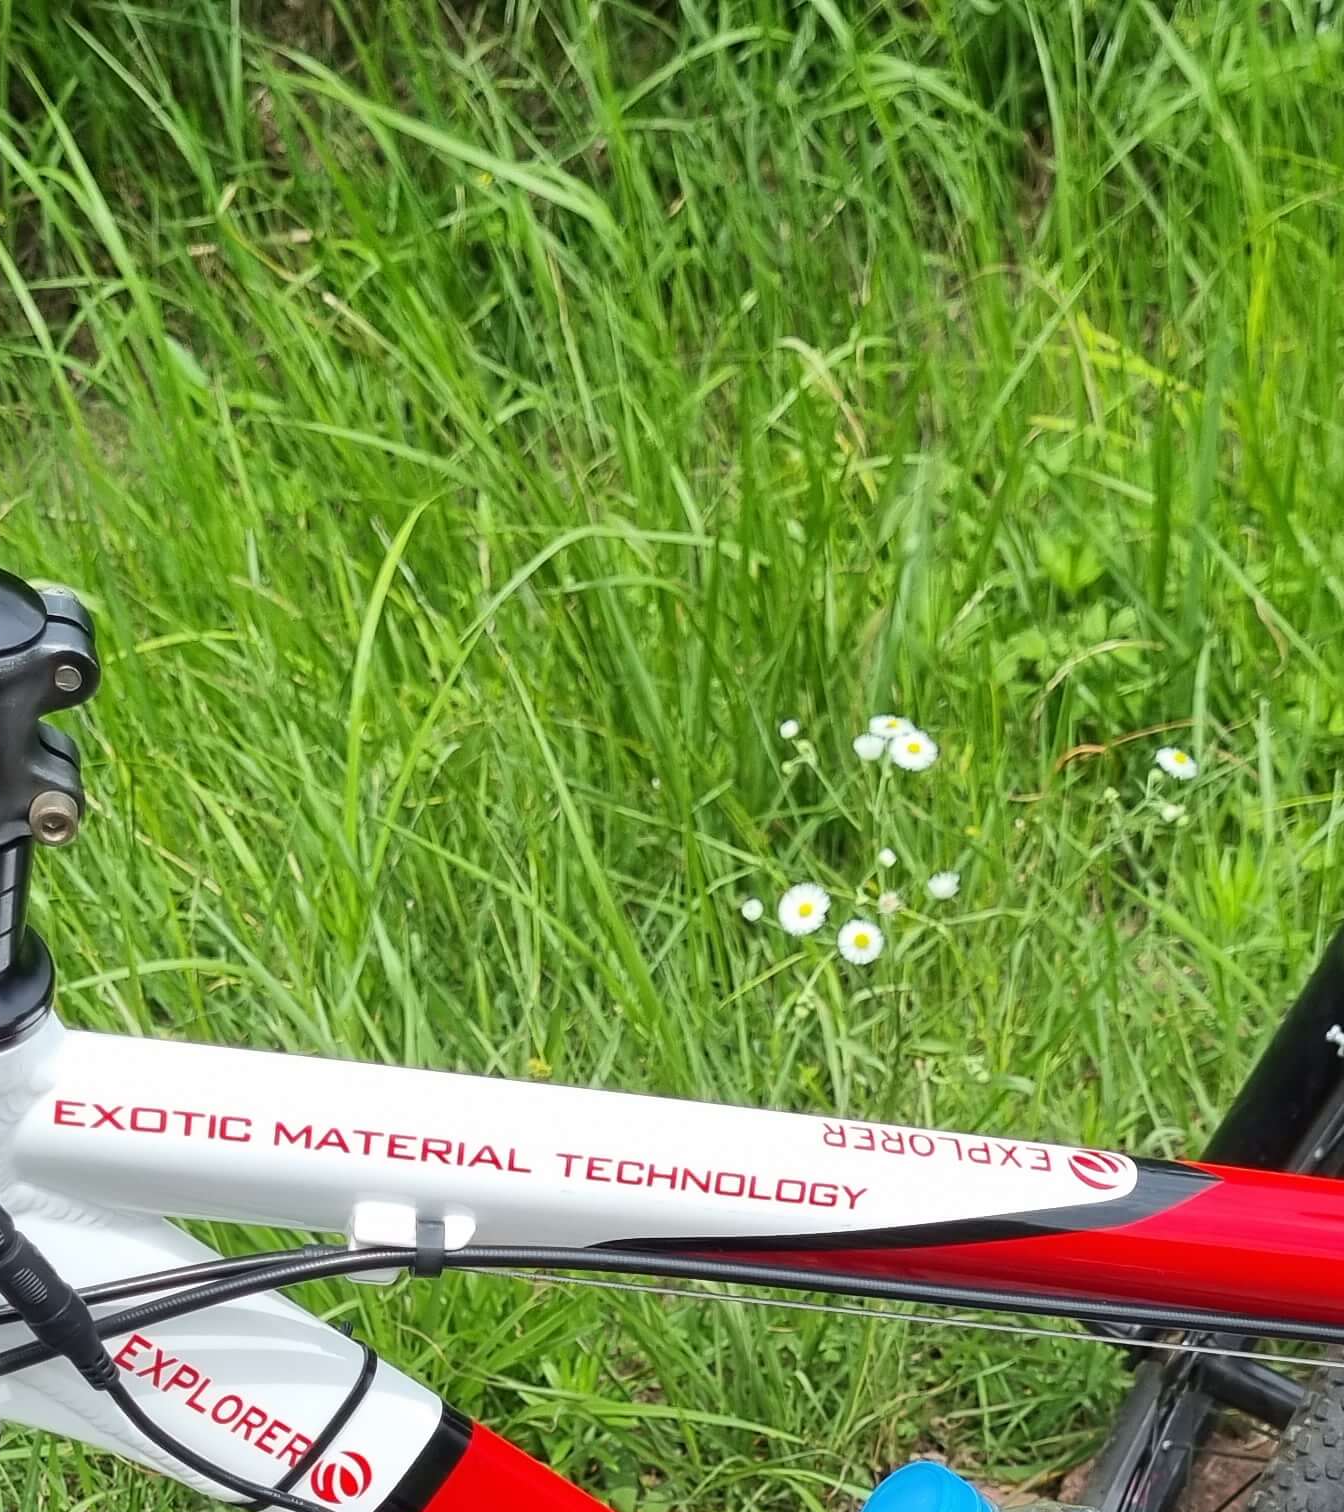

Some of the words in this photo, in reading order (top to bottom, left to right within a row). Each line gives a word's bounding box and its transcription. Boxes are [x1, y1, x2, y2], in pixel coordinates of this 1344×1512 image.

[52, 1100, 254, 1146] EXOTIC
[273, 1119, 532, 1176] MATERIAL
[556, 1152, 870, 1211] TECHNOLOGY
[820, 1120, 1054, 1172] EXPLORER
[113, 1333, 316, 1468] EXPLORER
